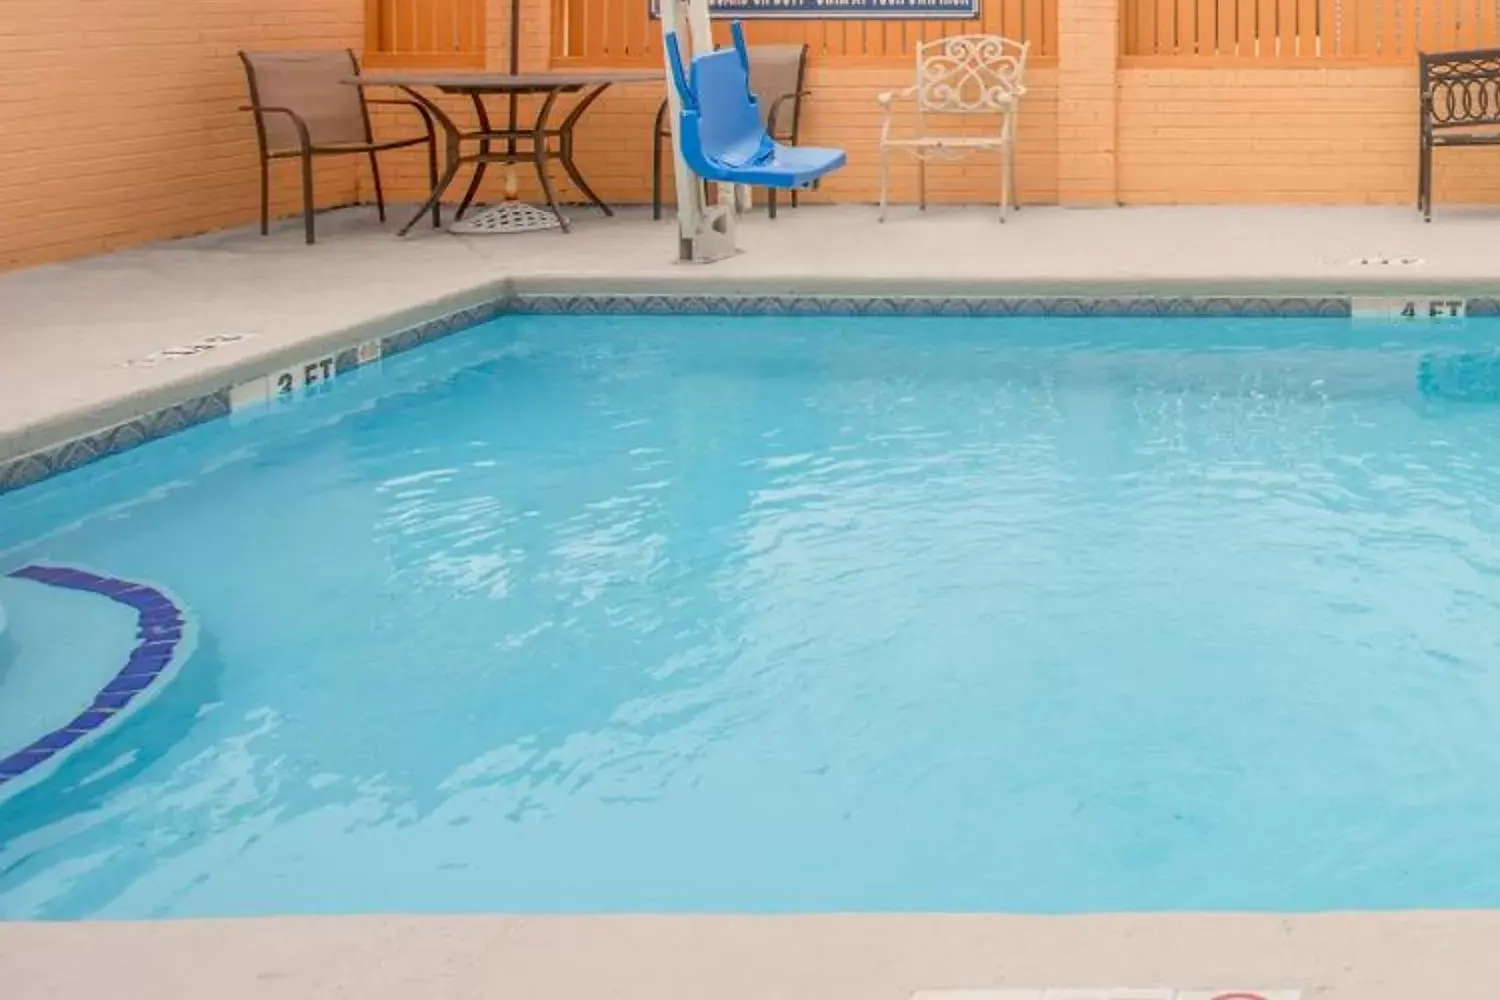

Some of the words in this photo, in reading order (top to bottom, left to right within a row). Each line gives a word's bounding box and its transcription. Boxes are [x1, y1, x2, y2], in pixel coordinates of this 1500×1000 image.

[1400, 301, 1416, 318] 4
[1428, 301, 1463, 317] FT
[304, 357, 333, 386] FT
